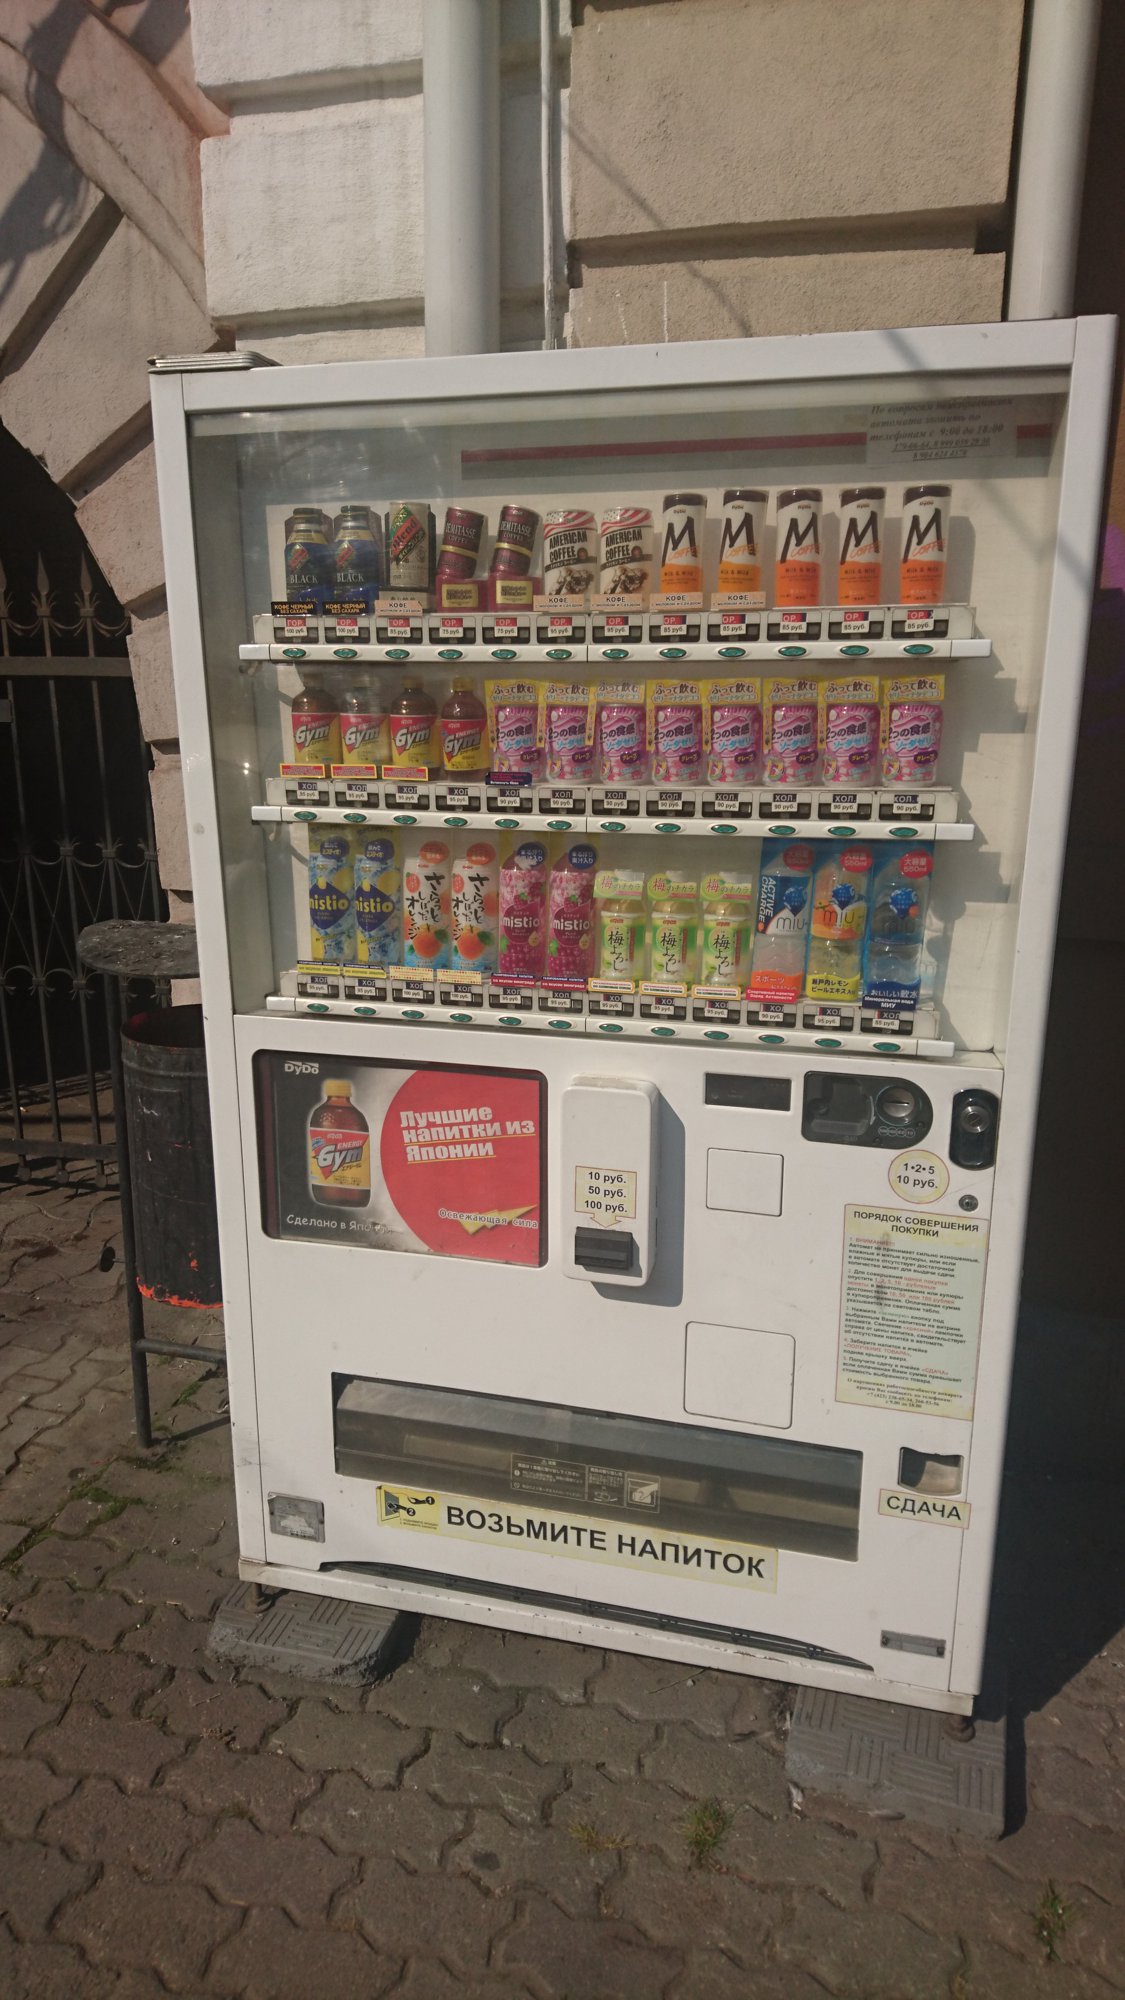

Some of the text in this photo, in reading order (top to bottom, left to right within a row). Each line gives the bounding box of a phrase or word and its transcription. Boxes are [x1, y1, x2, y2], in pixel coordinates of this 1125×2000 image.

[550, 531, 587, 549] AMERICAN
[606, 529, 642, 548] AMERICAN
[550, 546, 576, 562] COFFEE
[606, 546, 630, 562] COFFEE
[290, 575, 318, 583] BLACK
[337, 573, 364, 582] BLACK
[672, 626, 685, 634] руб.
[296, 725, 330, 746] Gym
[345, 725, 379, 747] Gym
[395, 728, 430, 749] Gym
[444, 733, 481, 755] Gym
[759, 877, 768, 922] CHARGE
[766, 877, 776, 917] ACTIVE
[503, 917, 539, 928] mistio
[554, 919, 590, 930] mistio
[284, 1060, 319, 1075] DyDo
[400, 1106, 492, 1127] Лучшие
[402, 1120, 535, 1143] напитки из
[337, 1140, 362, 1150] ENERGY
[406, 1142, 494, 1162] Японии
[317, 1142, 362, 1172] Gym
[588, 1172, 626, 1184] 10 руб.
[897, 1176, 937, 1189] 10 руб.
[588, 1186, 626, 1198] 50 руб.
[585, 1201, 627, 1213] 100 руб.
[286, 1214, 338, 1229] Сделано
[439, 1208, 538, 1228] Освежающая сила
[854, 1211, 979, 1232] ПОРЯДОК СОВЕРШЕНИЯ
[891, 1225, 939, 1237] ПОКУПКИ
[886, 1496, 962, 1520] СДАЧА
[447, 1507, 765, 1578] ВОЗЬМИТЕ НАПИТОК
